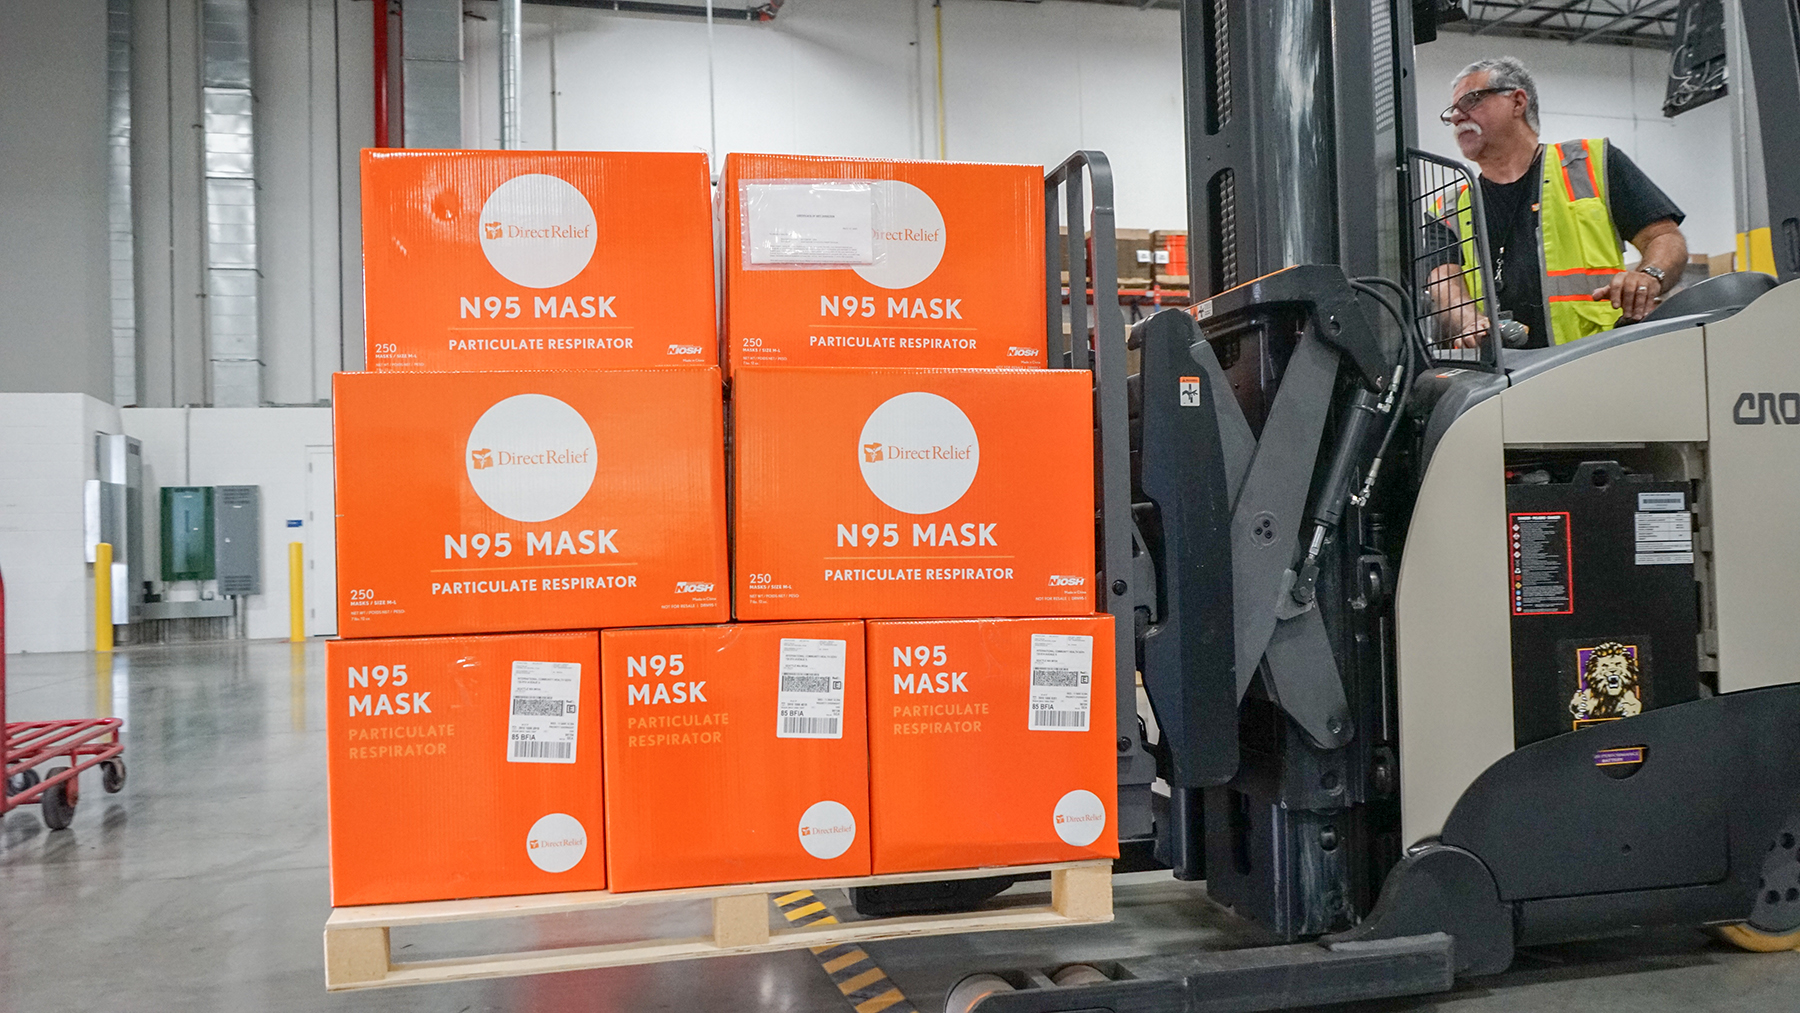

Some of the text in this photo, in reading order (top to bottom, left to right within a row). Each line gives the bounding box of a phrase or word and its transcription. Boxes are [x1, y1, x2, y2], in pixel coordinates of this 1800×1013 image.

[507, 222, 591, 239] Direct Relief
[904, 226, 941, 242] Relief
[460, 296, 617, 318] N95 MASK
[821, 296, 962, 319] N95 MASK
[375, 343, 397, 353] 250
[449, 338, 633, 350] PARTICULATE RESPIRATOR
[667, 345, 702, 355] NIOSH
[742, 338, 762, 347] 250
[810, 336, 976, 349] PARTICULATE RESPIRATOR
[1007, 346, 1039, 356] NIOSH
[497, 448, 590, 467] Direct Relief
[887, 443, 972, 461] Direct Relief
[837, 523, 997, 547] N95 MASK
[445, 529, 619, 559] N95 MASK
[749, 573, 772, 584] 250
[825, 568, 1013, 580] PARTICULATE RESPIRATOR
[1048, 575, 1084, 586] NIOSH
[432, 576, 636, 594] PARTICULATE RESPIRATOR
[674, 581, 714, 593] NIOSH
[350, 589, 374, 600] 250
[894, 646, 947, 667] N95
[628, 655, 684, 677] N95
[348, 665, 407, 688] N95
[894, 672, 968, 694] MASK
[628, 681, 707, 705] MASK
[349, 692, 431, 717] MASK
[894, 704, 988, 717] PARTICULATE
[628, 713, 729, 728] PARTICULATE
[894, 721, 981, 734] RESPIRATOR
[349, 724, 454, 740] PARTICULATE
[629, 732, 721, 747] RESPIRATOR
[350, 743, 446, 759] RESPIRATOR
[834, 824, 852, 834] Relief
[540, 836, 583, 848] Direct Relief
